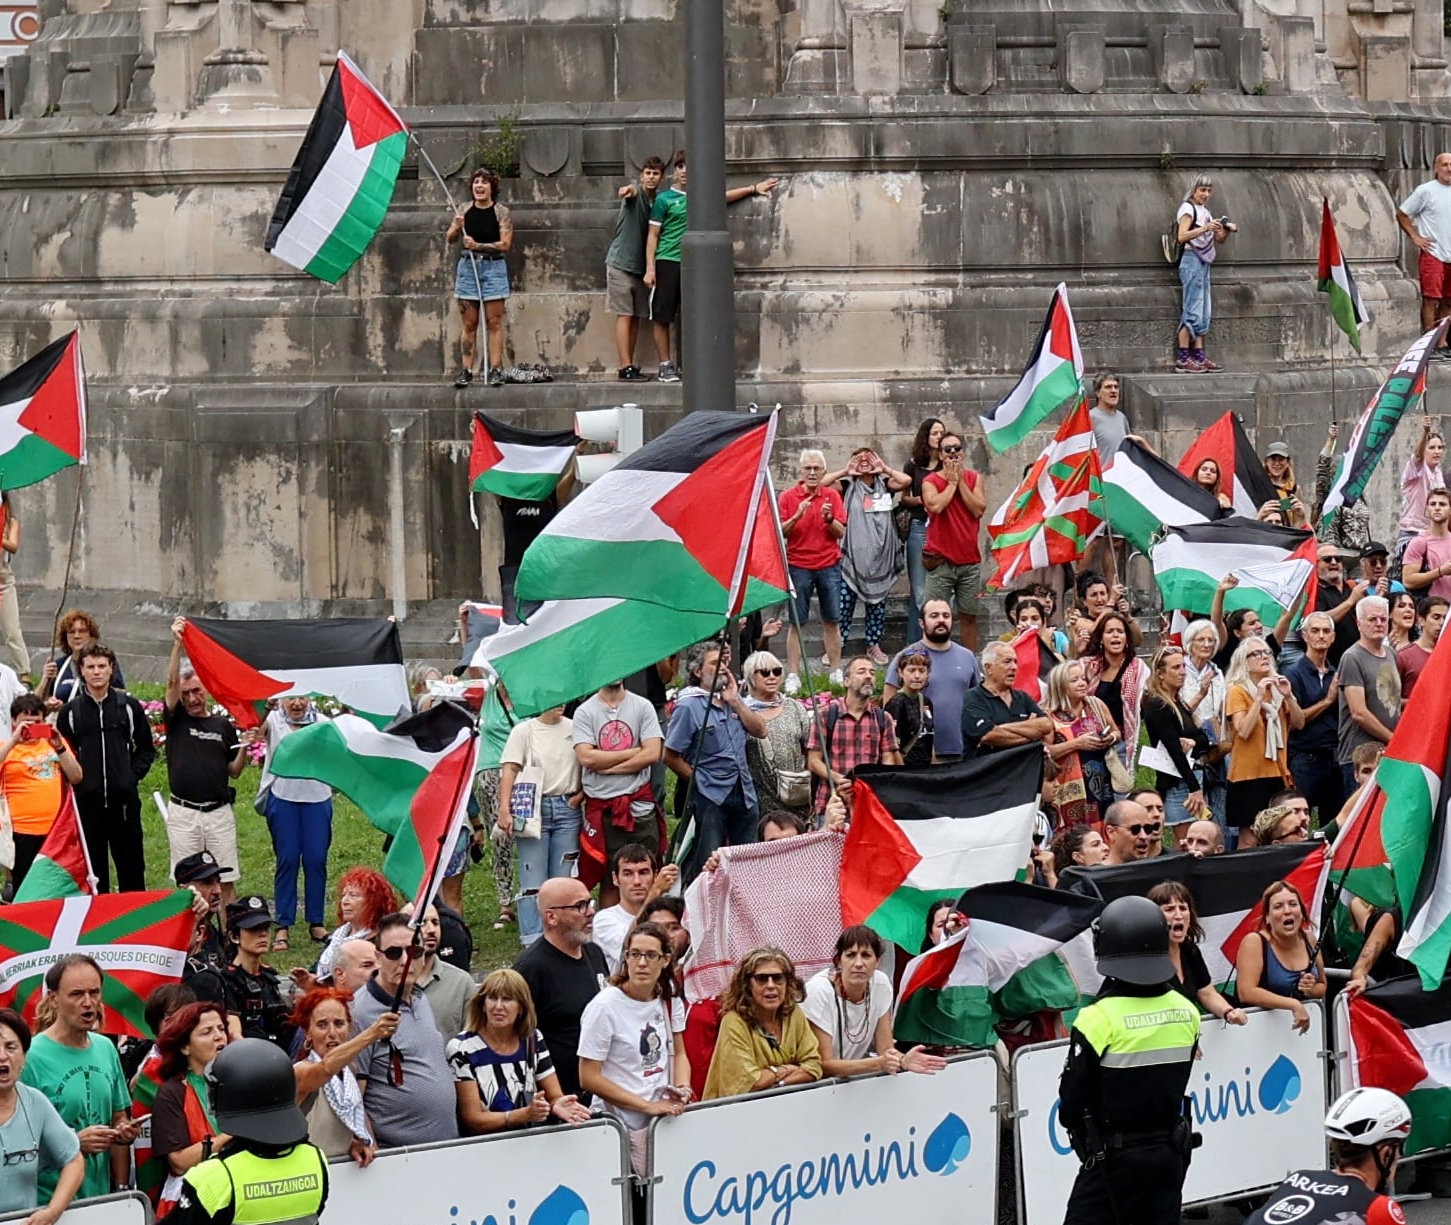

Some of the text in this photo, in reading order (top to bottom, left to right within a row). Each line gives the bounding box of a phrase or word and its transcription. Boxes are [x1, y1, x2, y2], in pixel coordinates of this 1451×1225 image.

[134, 952, 173, 968] DECIDE
[245, 1175, 317, 1199] UDALTZAINGOA
[1283, 1173, 1349, 1196] ARKEA
[1274, 1201, 1308, 1215] B&B
